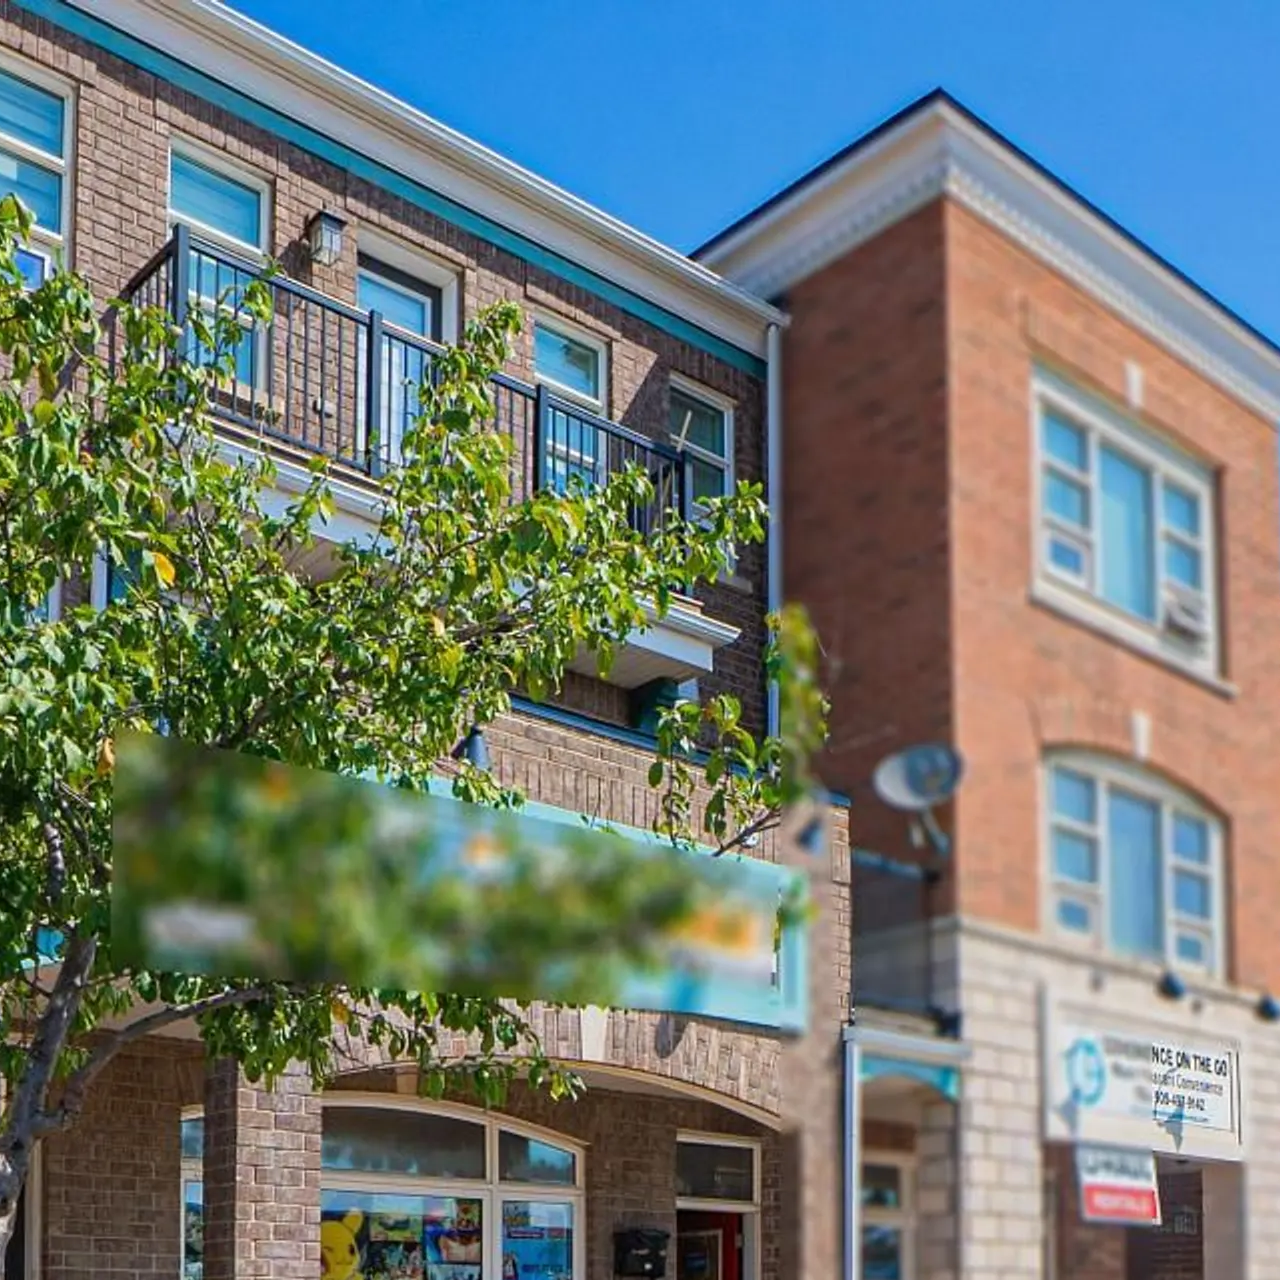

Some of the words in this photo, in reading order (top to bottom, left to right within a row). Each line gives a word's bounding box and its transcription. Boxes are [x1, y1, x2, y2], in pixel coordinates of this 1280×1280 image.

[1176, 1051, 1192, 1070] ON
[1193, 1054, 1213, 1073] THE
[1214, 1058, 1228, 1077] GO
